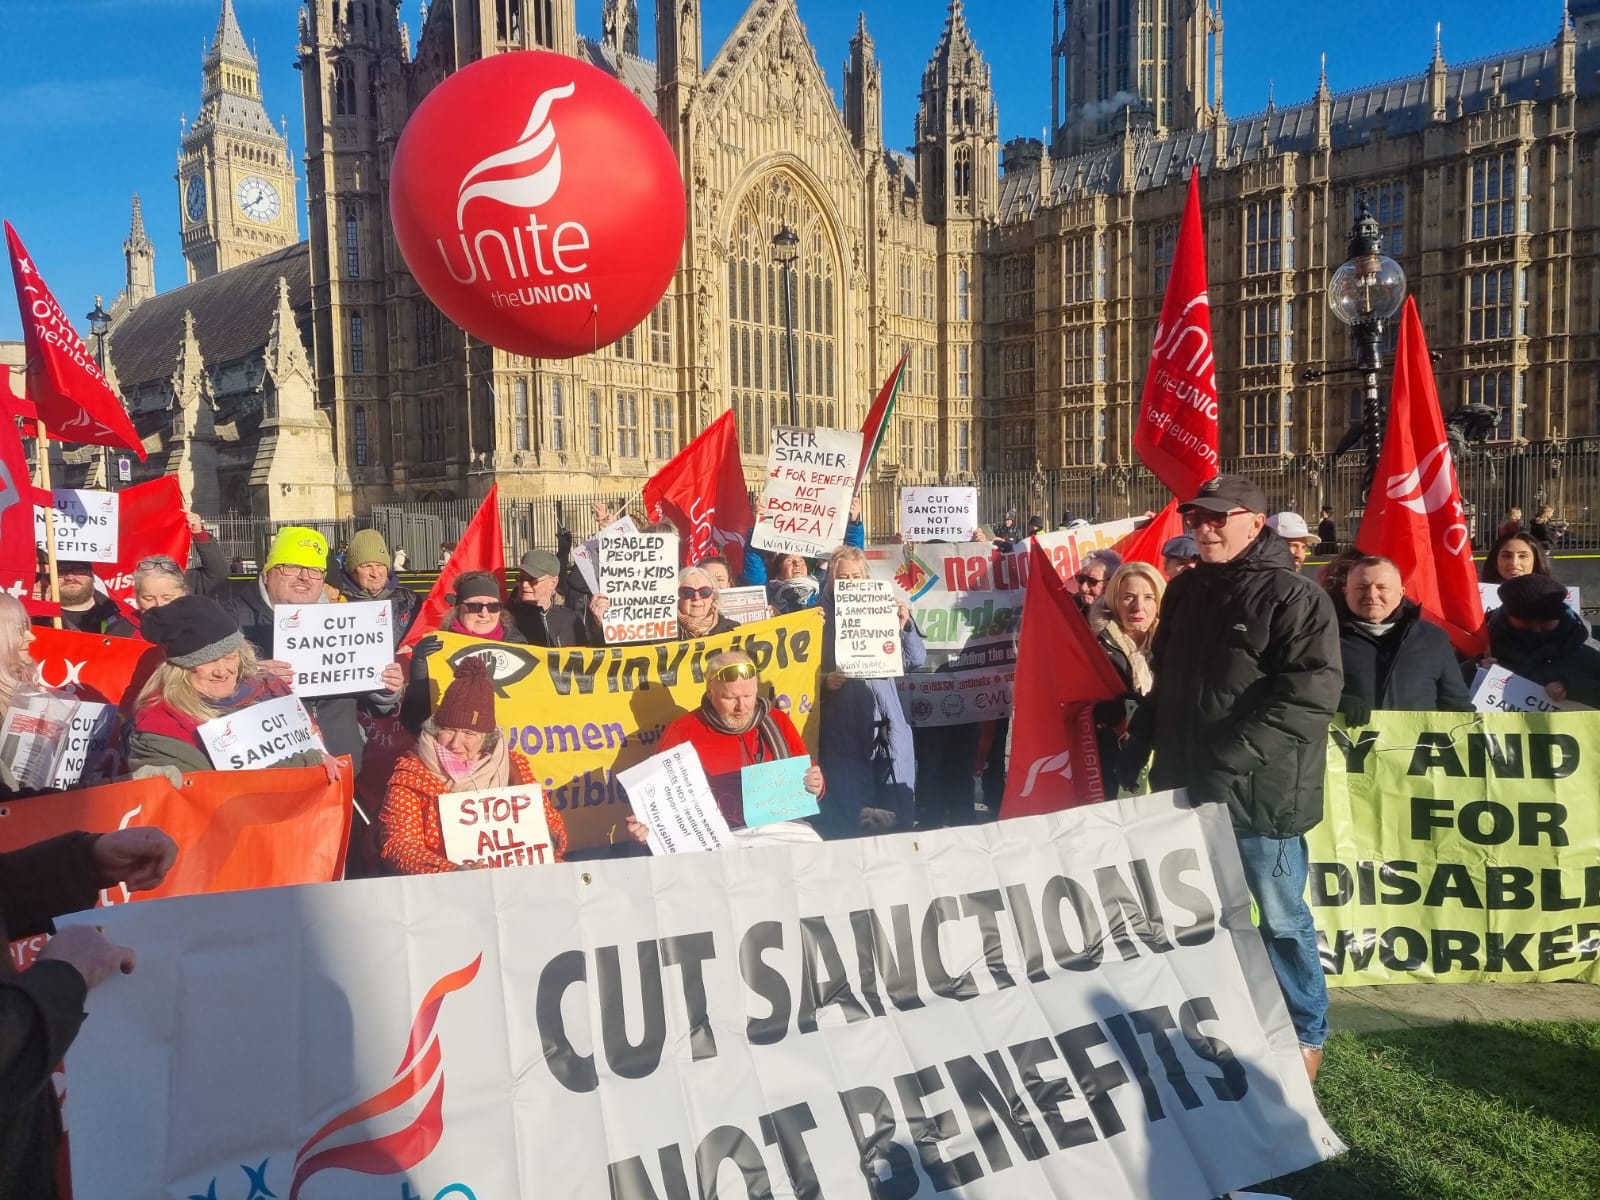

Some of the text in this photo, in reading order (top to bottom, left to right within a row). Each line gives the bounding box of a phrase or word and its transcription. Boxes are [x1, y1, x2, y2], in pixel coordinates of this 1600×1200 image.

[437, 213, 590, 285] unite
[490, 281, 592, 309] theUNION
[776, 430, 818, 448] KEIR
[770, 466, 855, 488] £ FOR BENEFITS
[795, 486, 825, 499] NOT
[768, 498, 837, 519] BOMBING
[907, 506, 969, 514] SANCTIONS
[928, 516, 949, 524] NOT
[602, 537, 664, 550] DISABLED
[600, 566, 634, 578] MUMS
[644, 566, 675, 579] KIDS
[606, 580, 657, 593] STARVE
[838, 581, 883, 592] BENEFIT
[608, 595, 676, 607] ILLIONAIRES
[836, 593, 893, 603] DEDUCTIONS
[623, 606, 672, 621] RICHER
[836, 606, 893, 616] & SANCTIONS
[324, 616, 356, 630] CUT
[605, 621, 678, 641] OBSCENE
[841, 618, 861, 628] ARE
[286, 631, 384, 650] SANCTIONS
[840, 628, 894, 640] STARVING
[852, 640, 867, 651] US
[322, 651, 356, 666] NOT
[298, 666, 375, 685] BENEFITS
[261, 713, 288, 733] CUT
[230, 727, 311, 770] SANCTIONS
[1329, 730, 1581, 780] Y AND
[459, 795, 531, 826] STOP
[649, 801, 677, 854] WinVisible
[1410, 797, 1570, 847] FOR
[477, 827, 525, 856] ALL
[536, 847, 1216, 1093] CUT SANCTIONS
[837, 996, 1249, 1200] BENEFITS
